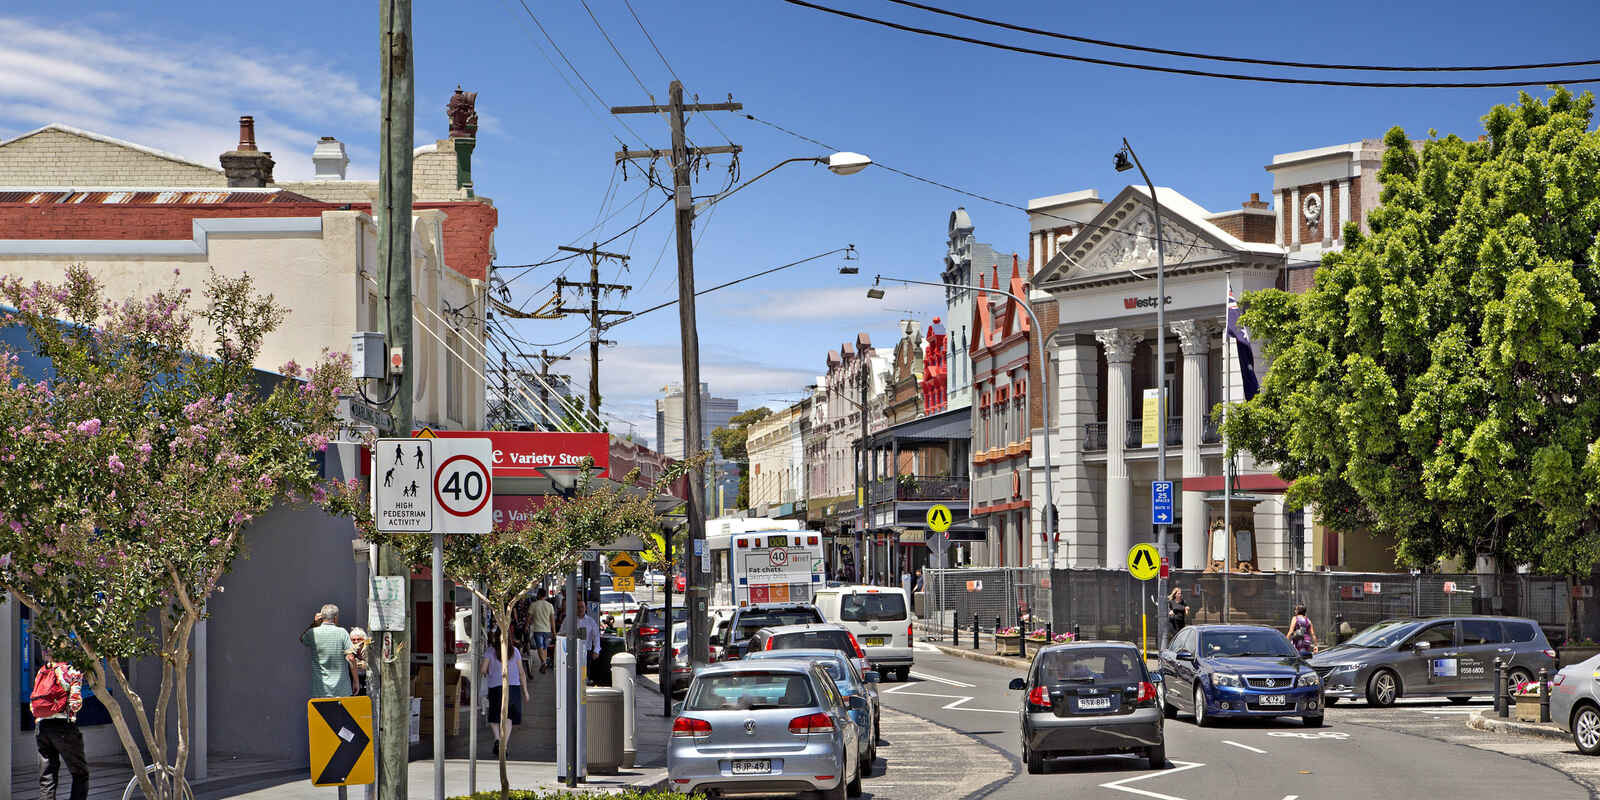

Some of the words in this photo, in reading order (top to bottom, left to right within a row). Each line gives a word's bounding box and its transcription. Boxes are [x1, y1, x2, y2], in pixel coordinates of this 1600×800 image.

[509, 452, 556, 467] Variety
[442, 471, 483, 501] 40
[1156, 483, 1169, 492] 2P
[383, 510, 426, 518] PEDESTRIAN
[388, 518, 421, 526] ACTIVITY
[772, 551, 785, 561] 40
[618, 577, 631, 587] 25
